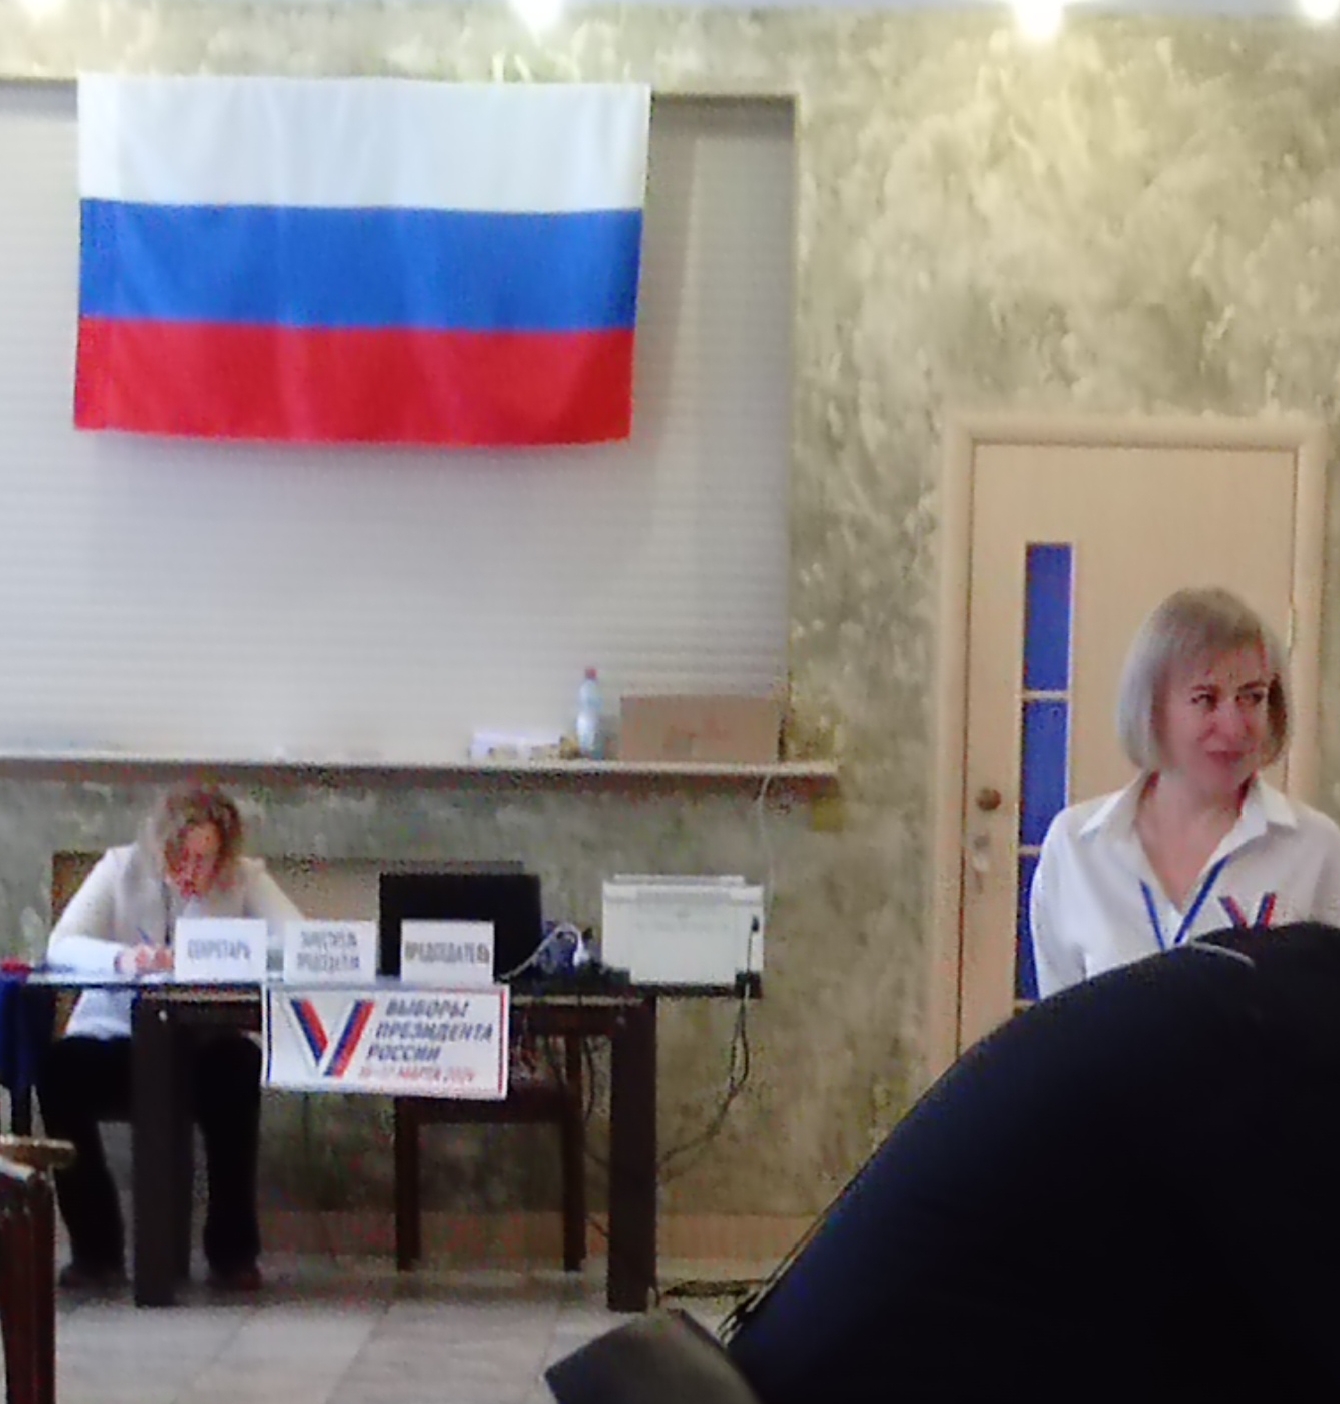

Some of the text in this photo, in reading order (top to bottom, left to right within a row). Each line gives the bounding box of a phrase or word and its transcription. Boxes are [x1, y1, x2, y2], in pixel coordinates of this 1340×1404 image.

[385, 999, 470, 1018] ВЫБОРЫ
[375, 1022, 494, 1043] ПРЕЗИДЕНТА
[366, 1043, 442, 1061] РОССИИ
